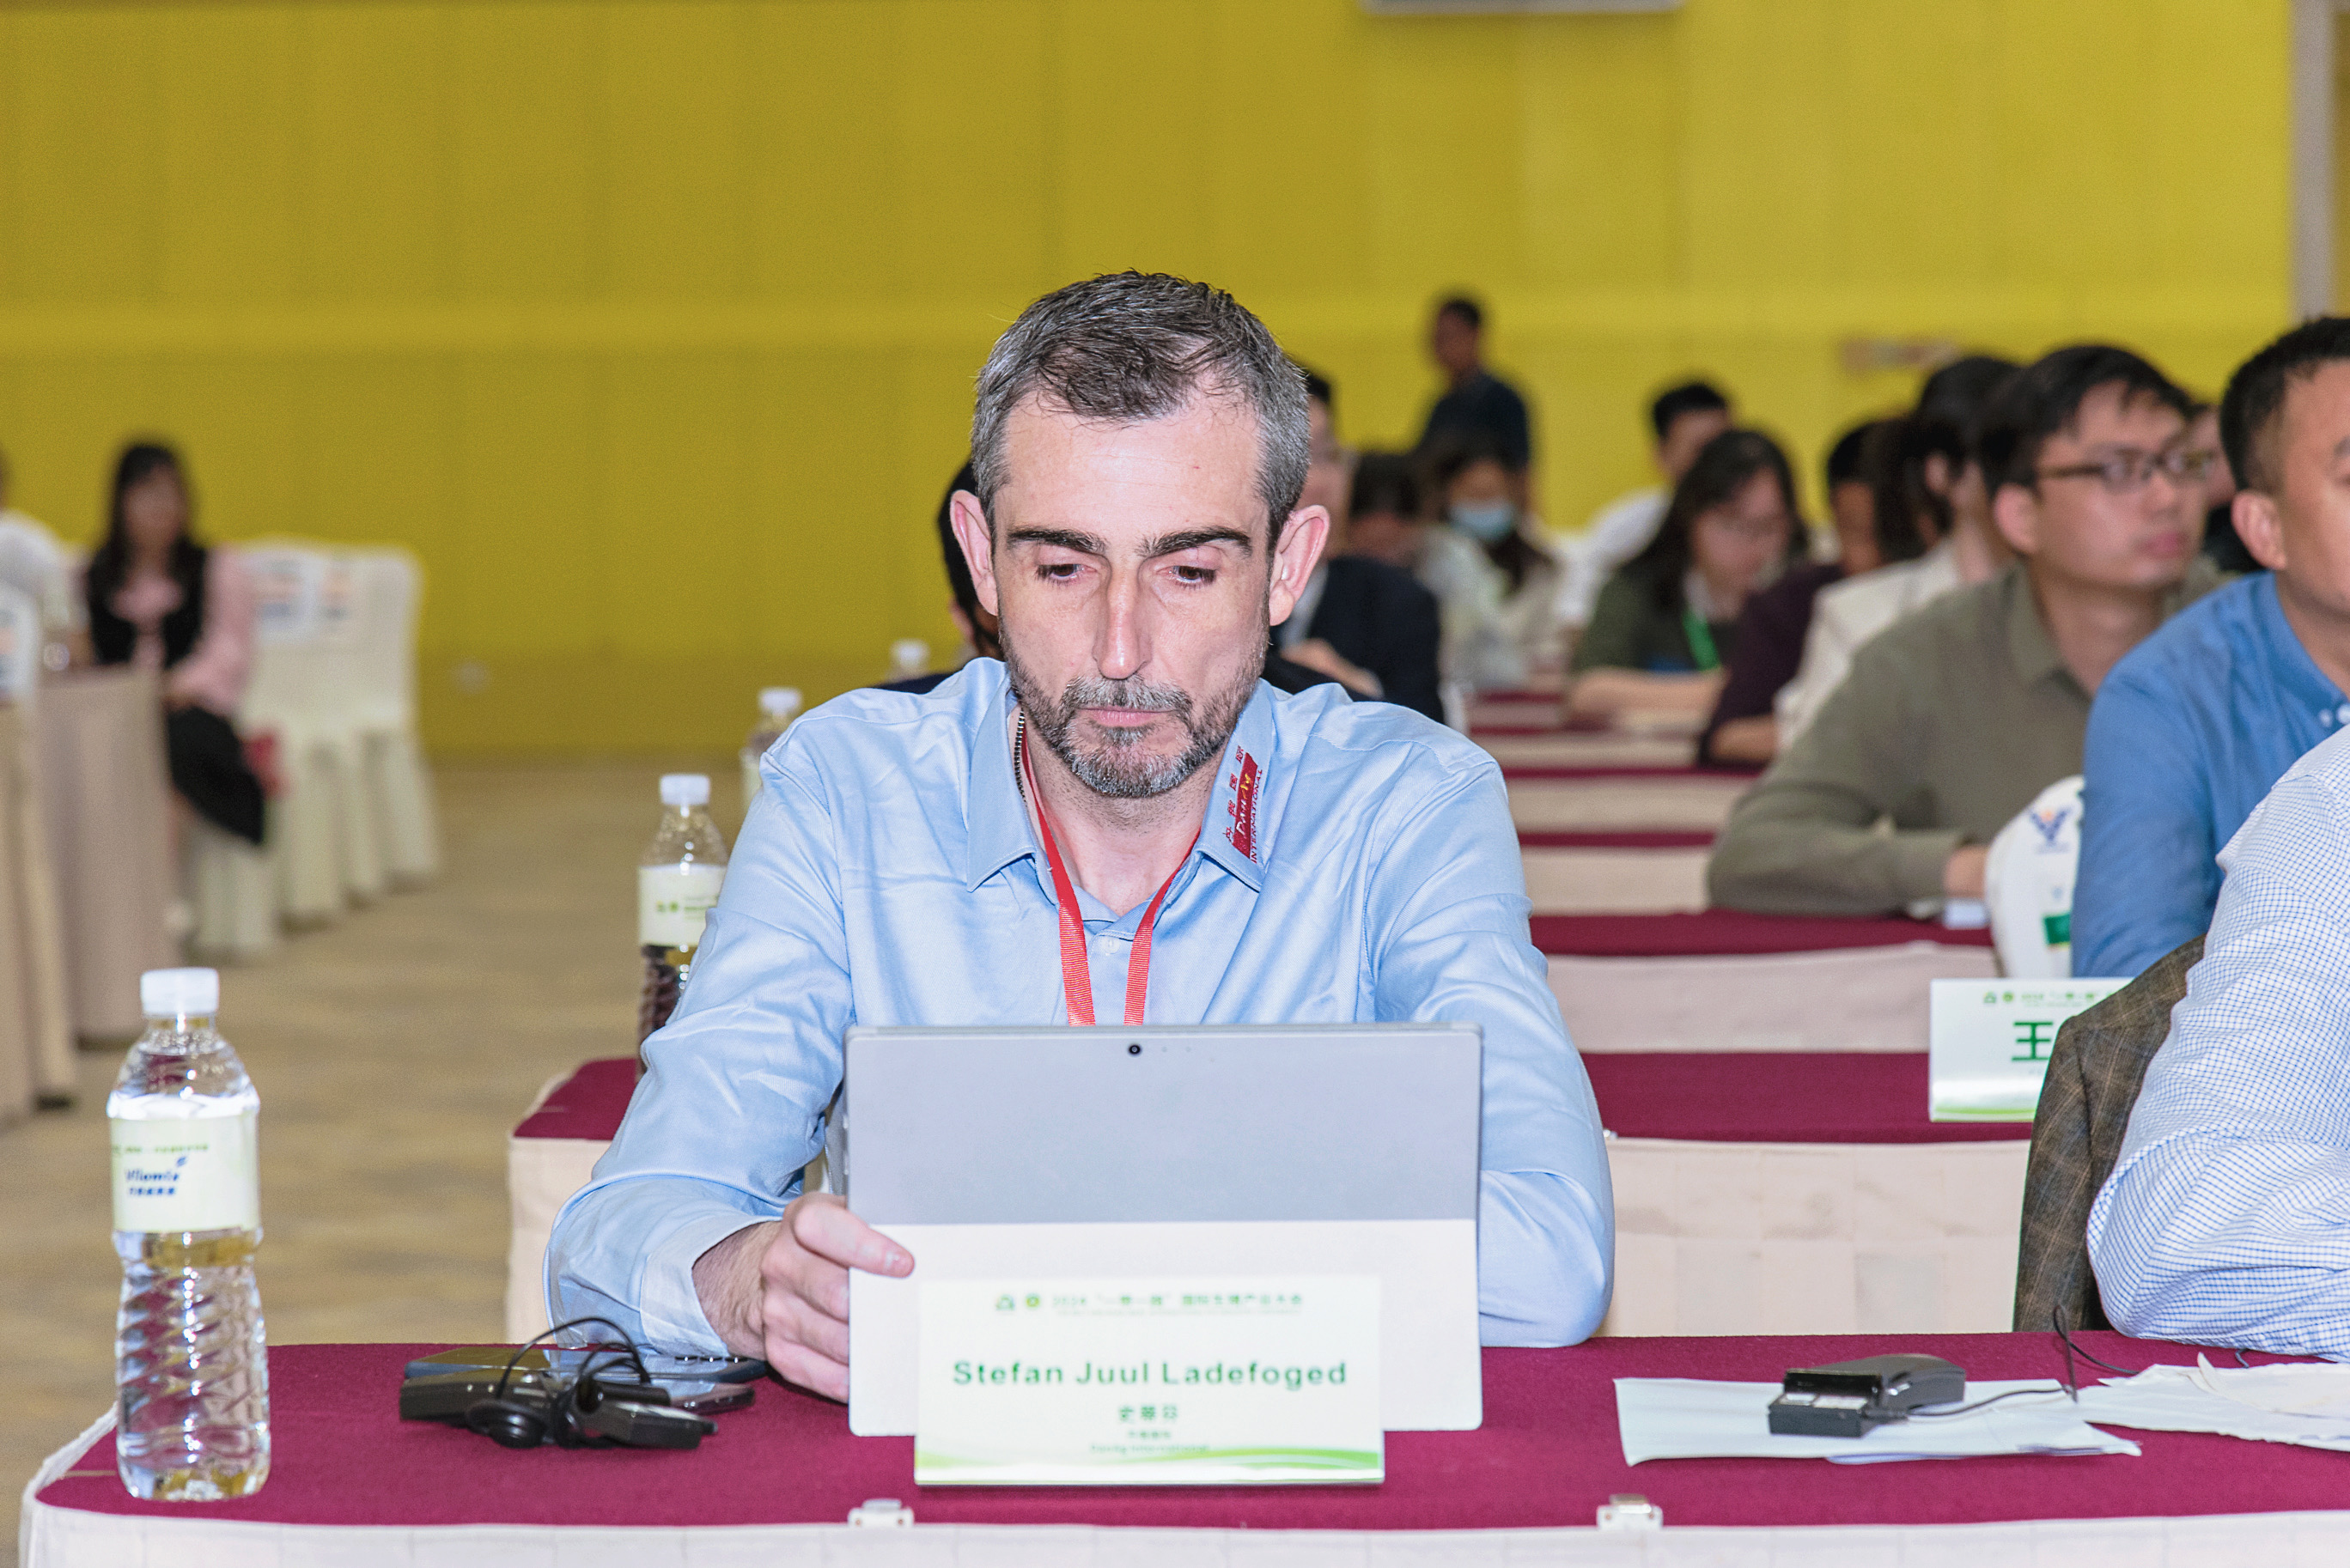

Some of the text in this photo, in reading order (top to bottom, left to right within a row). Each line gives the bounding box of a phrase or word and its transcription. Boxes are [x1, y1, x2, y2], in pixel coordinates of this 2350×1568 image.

[1250, 769, 1263, 864] INTERNATIONAL
[953, 1360, 1348, 1390] Stefan Juul Ladefoged
